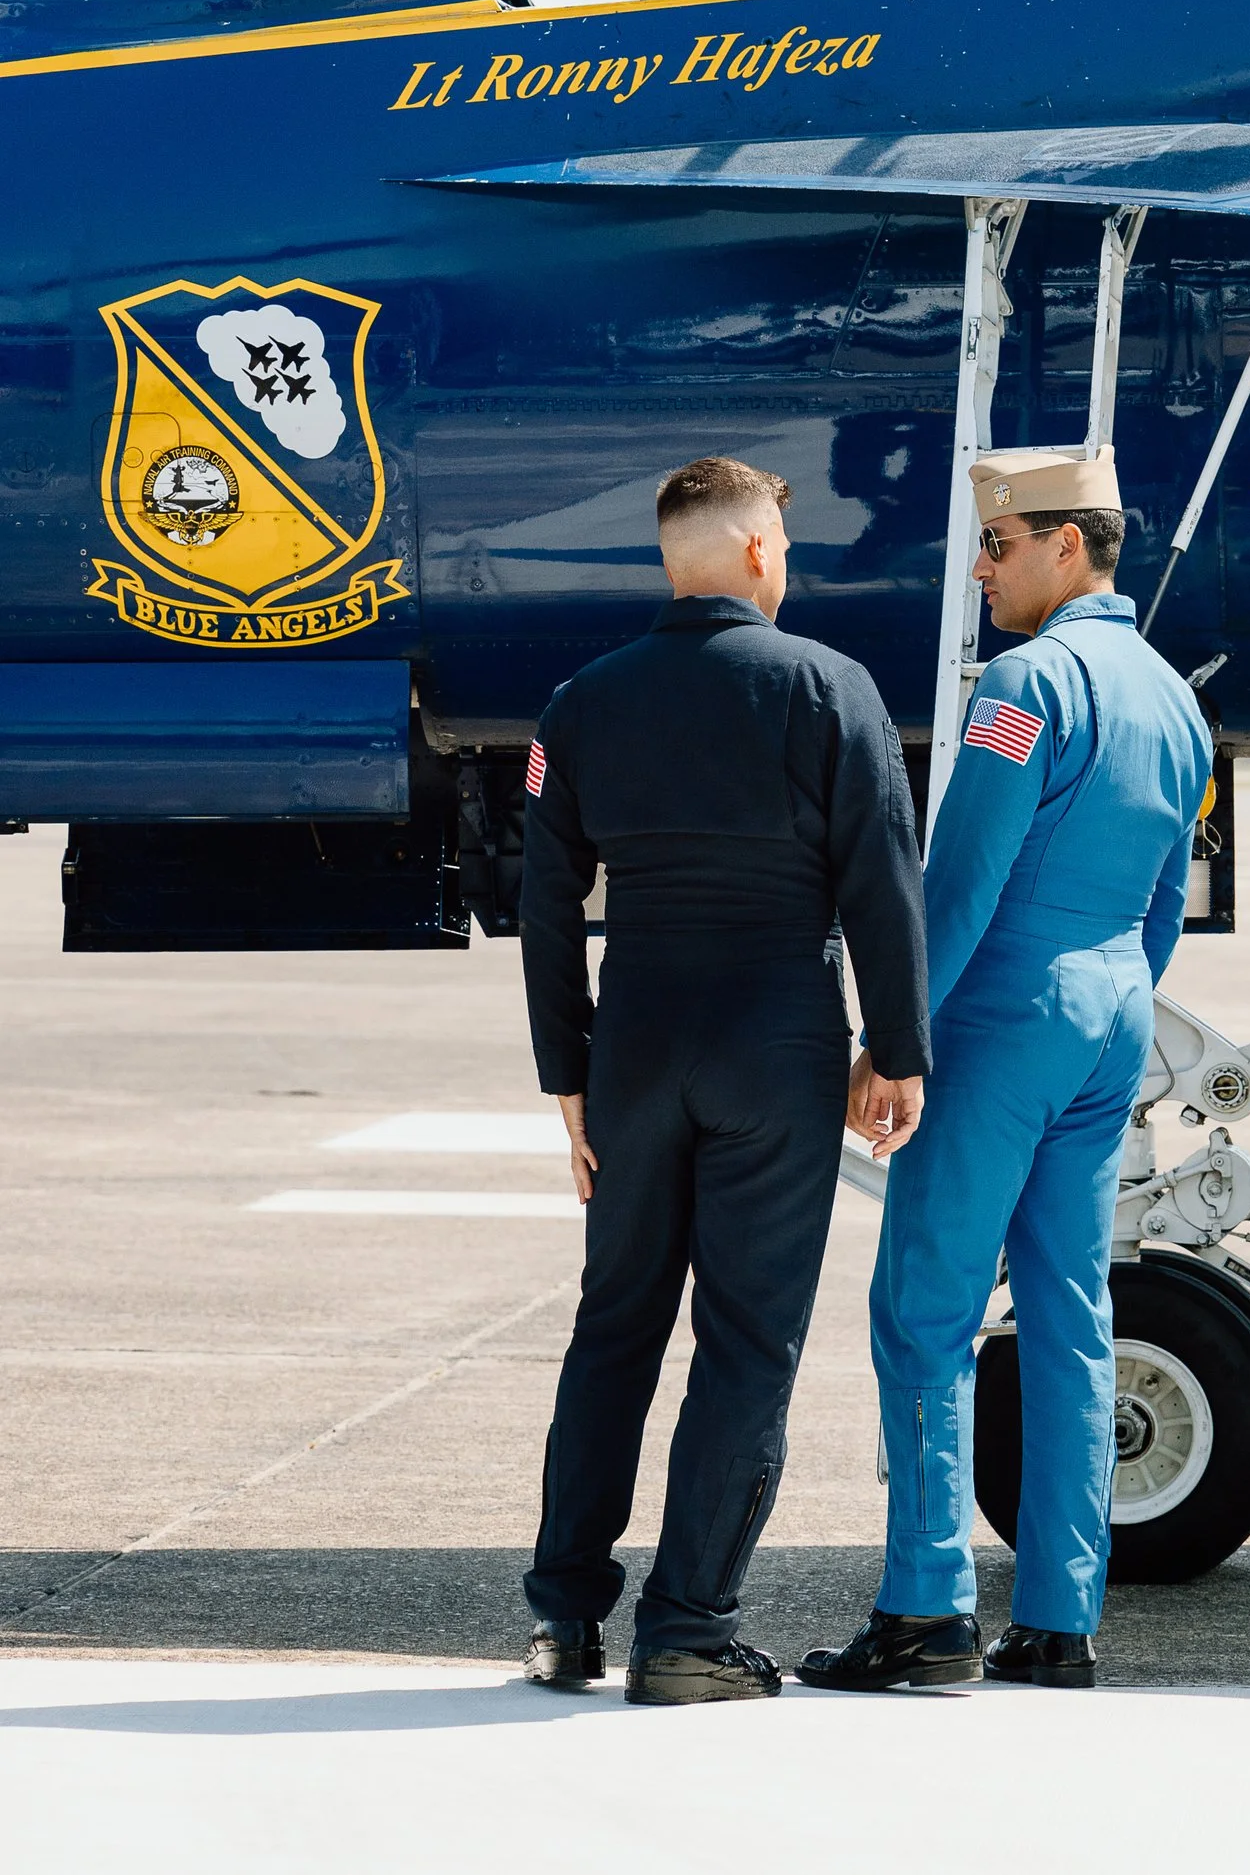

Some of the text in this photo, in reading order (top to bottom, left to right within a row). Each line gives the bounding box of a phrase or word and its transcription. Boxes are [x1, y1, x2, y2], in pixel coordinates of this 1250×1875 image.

[387, 26, 881, 111] Lt Ronny Hafeza
[143, 446, 238, 496] NAVAL AIR TRAINING COMMAND
[134, 595, 364, 640] BLUE ANGELS
